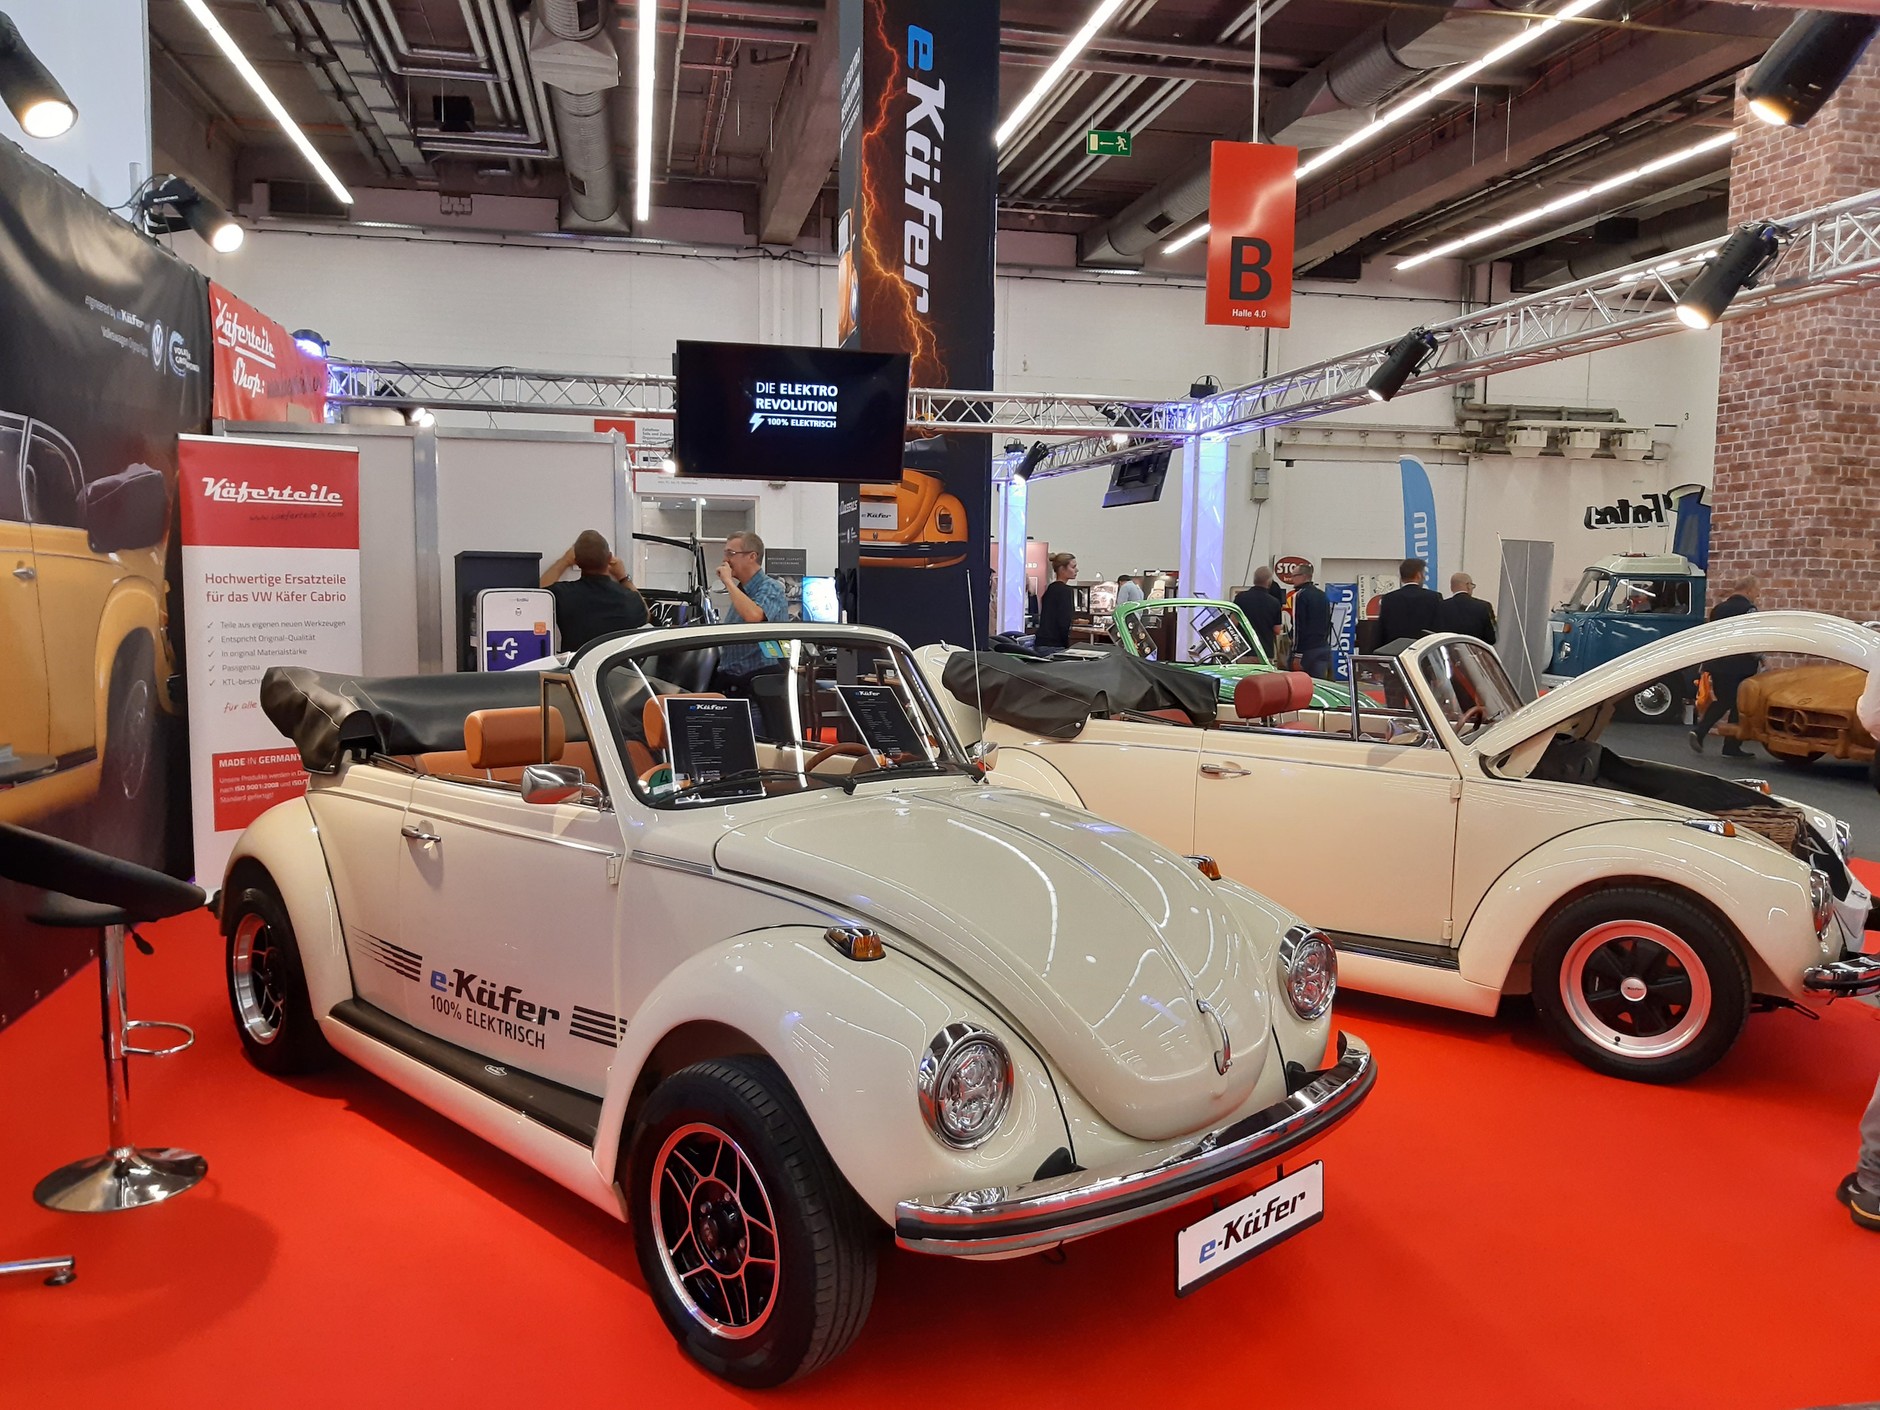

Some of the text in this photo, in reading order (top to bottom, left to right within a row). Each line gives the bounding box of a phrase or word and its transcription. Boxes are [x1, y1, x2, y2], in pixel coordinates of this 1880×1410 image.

[1229, 235, 1272, 301] B
[1231, 308, 1268, 319] Halle 4.0
[215, 296, 275, 359] Käferteile
[232, 356, 265, 399] Shop:
[755, 381, 838, 398] DIE ELEKTRO
[755, 397, 838, 413] REVOLUTION
[766, 417, 837, 429] 100% ELEKTRISCH
[1684, 412, 1690, 421] 3
[202, 476, 344, 503] Käferteile
[205, 573, 347, 587] Hochwertige Ersatzteile
[206, 590, 347, 603] für das VW Käfer Cabrio
[221, 621, 238, 630] Teile
[252, 622, 280, 631] eigenen
[304, 619, 346, 628] Werkzeugen
[221, 634, 316, 645] Entspricht Original-Qualität
[230, 650, 256, 659] original
[222, 664, 260, 674] Passgenau
[222, 678, 261, 686] KTL-beschi
[241, 700, 258, 709] alle
[219, 753, 302, 768] MADE IN GERMANY
[660, 769, 669, 783] 4
[234, 784, 246, 792] ISO
[292, 779, 309, 787] ISO/T
[430, 968, 560, 1027] e-Käfer
[430, 993, 546, 1051] 100% ELEKTRISCH
[1198, 1191, 1306, 1264] e-Käfer
